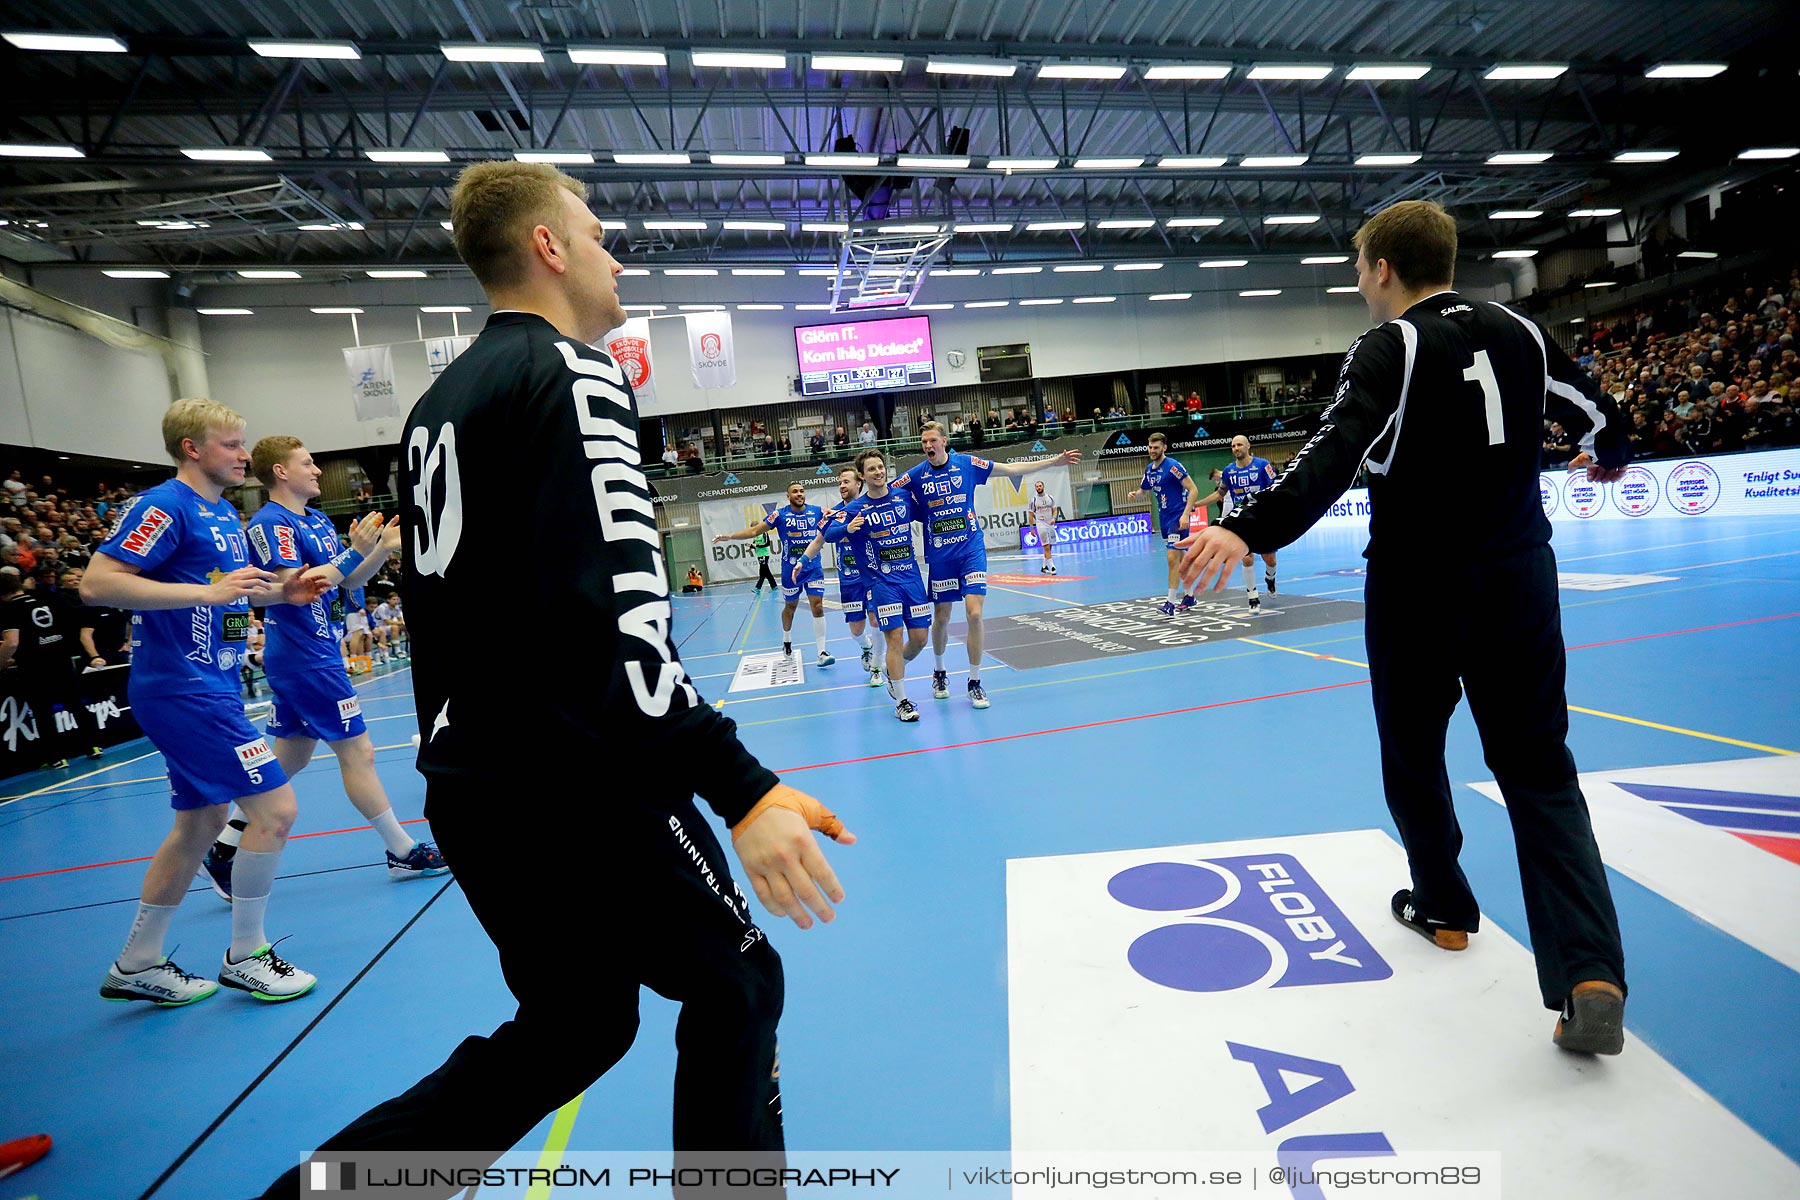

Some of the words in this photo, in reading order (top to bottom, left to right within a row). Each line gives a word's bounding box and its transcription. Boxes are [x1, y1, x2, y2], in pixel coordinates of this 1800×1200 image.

[616, 338, 639, 347] SKÖVDE
[801, 329, 840, 344] Glöm
[803, 349, 836, 363] Kom
[836, 345, 866, 361] ihåg
[698, 360, 728, 369] SKÖVDE
[363, 380, 393, 389] ARENA
[362, 388, 394, 398] SKÖVDE
[1463, 350, 1505, 445] 1
[1249, 430, 1307, 441] ONEPARTNERGROUP
[1229, 475, 1237, 485] 11
[697, 484, 768, 498] ONEPARTNERGROUP
[922, 482, 935, 495] 28
[407, 421, 463, 578] 30
[934, 507, 963, 517] VOLVO
[786, 518, 796, 527] 24
[865, 512, 880, 526] 10
[121, 509, 167, 553] MAXI
[209, 526, 227, 551] 5
[279, 526, 294, 560] MAXI
[309, 534, 322, 552] 7
[877, 536, 908, 546] VOLVO
[943, 534, 968, 545] SKÖVDE
[879, 618, 888, 627] 10
[342, 720, 350, 732] 7
[248, 769, 263, 785] 5
[669, 815, 720, 895] TRAINING
[1246, 862, 1363, 968] FLOBY
